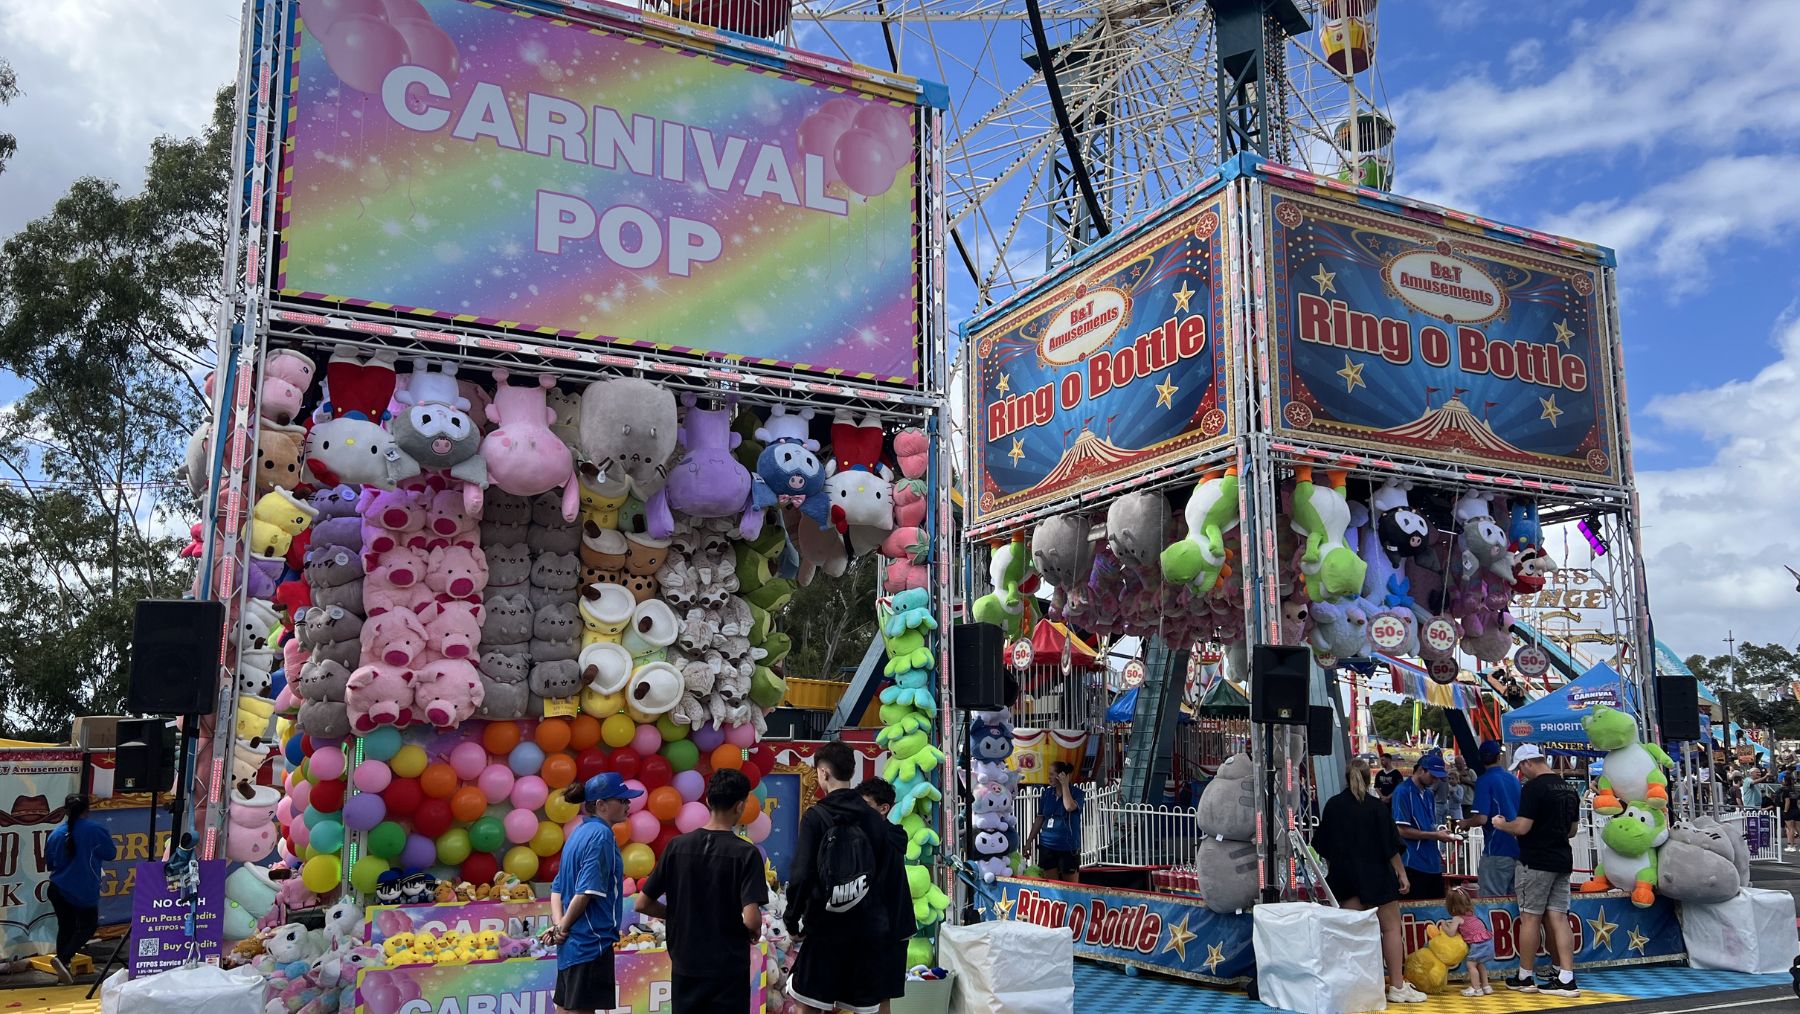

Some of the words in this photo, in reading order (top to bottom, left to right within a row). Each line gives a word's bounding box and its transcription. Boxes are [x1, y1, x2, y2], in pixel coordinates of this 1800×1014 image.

[382, 65, 848, 216] CARNIVAL
[535, 190, 722, 277] POP
[1430, 261, 1462, 282] B&T
[1400, 272, 1494, 306] Amusements
[1070, 301, 1094, 326] B&T
[1049, 305, 1119, 352] Amusements
[1298, 293, 1412, 365] Ring
[1457, 325, 1588, 391] Bottle
[988, 382, 1054, 442] Ring
[1089, 314, 1206, 400] Bottle
[1574, 691, 1613, 700] CARNIVAL
[12, 765, 80, 774] Amusements
[832, 875, 867, 904] NIKE
[153, 899, 172, 908] NO
[140, 915, 157, 923] Fun
[160, 914, 181, 922] Pass
[155, 924, 178, 932] EFTPOS
[1085, 898, 1161, 954] Bottle
[163, 943, 181, 952] Buy
[136, 960, 158, 969] EFTPOS
[159, 959, 181, 968] Service
